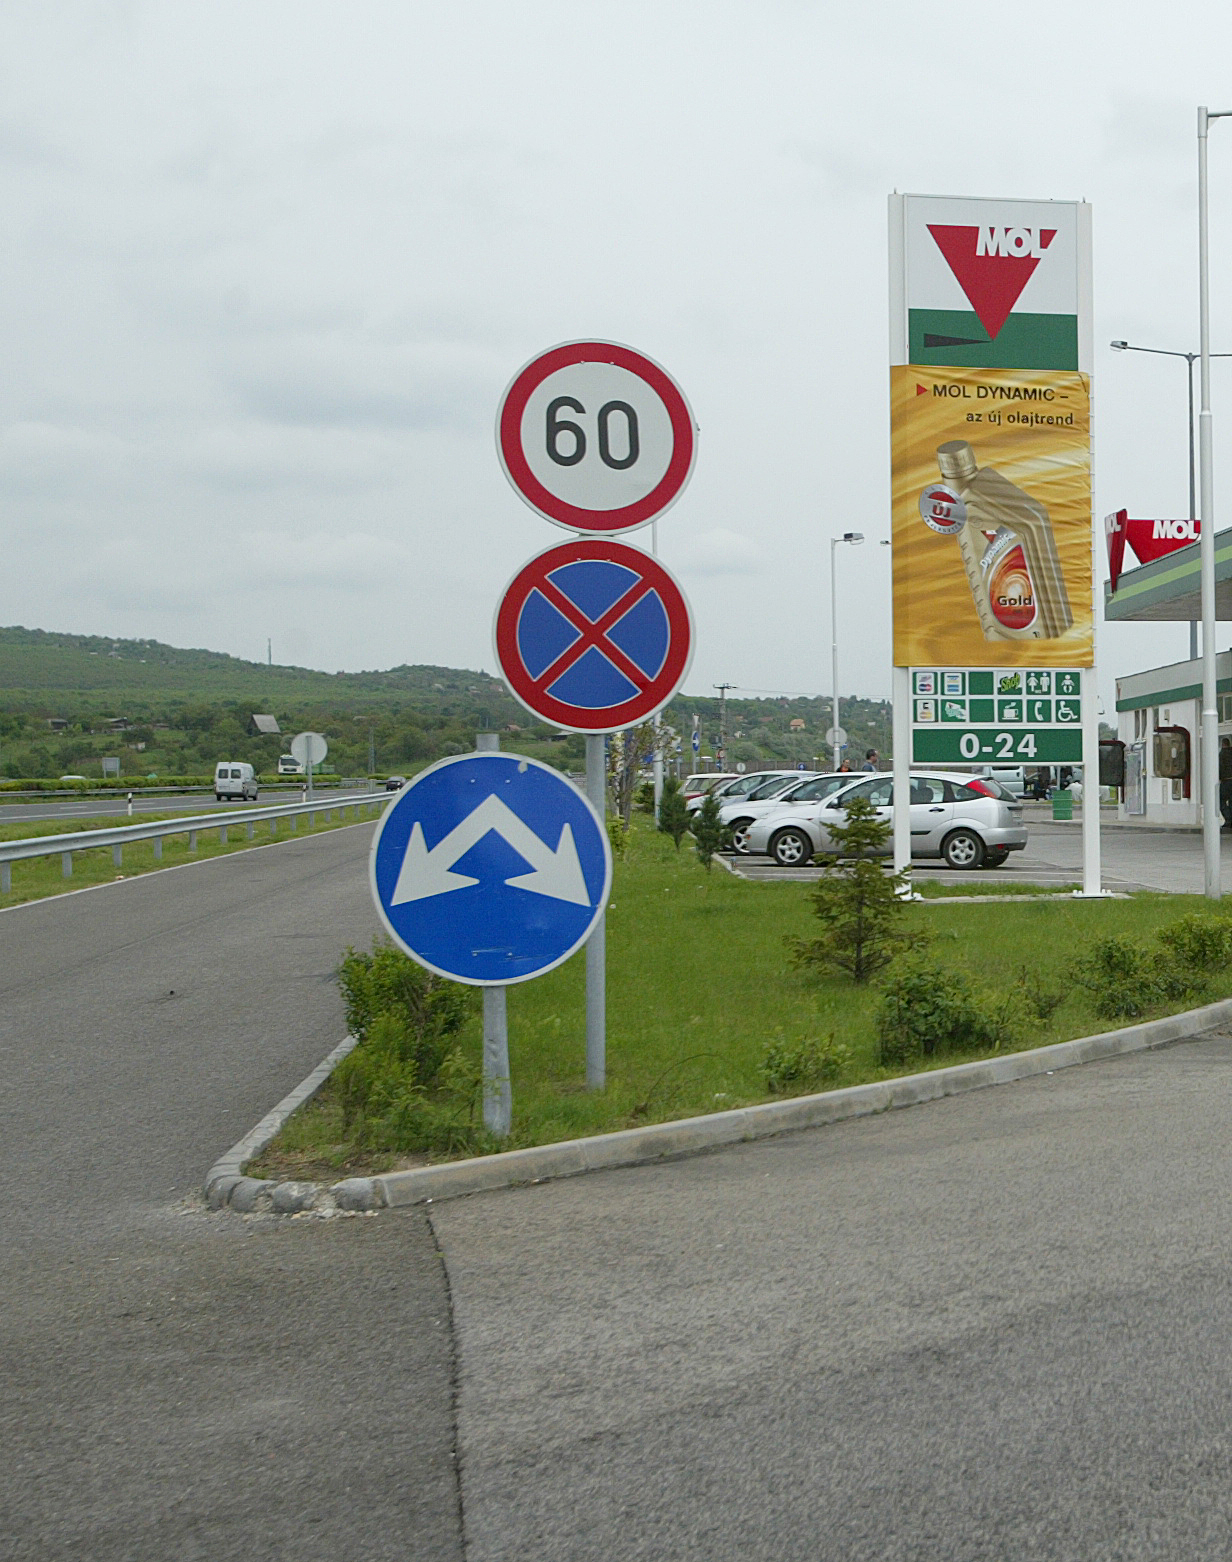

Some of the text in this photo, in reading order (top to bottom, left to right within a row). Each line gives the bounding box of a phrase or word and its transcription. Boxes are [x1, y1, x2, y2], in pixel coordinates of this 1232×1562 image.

[975, 226, 1044, 259] MOL
[933, 384, 972, 399] MOL
[976, 385, 1056, 402] DYNAMIC
[966, 410, 1074, 427] az új olajtrend
[546, 395, 640, 471] 60
[932, 502, 952, 518] ÚJ
[1152, 519, 1200, 540] MOL
[997, 595, 1032, 606] Gold
[999, 672, 1021, 692] Shop
[959, 732, 1038, 759] 0-24
